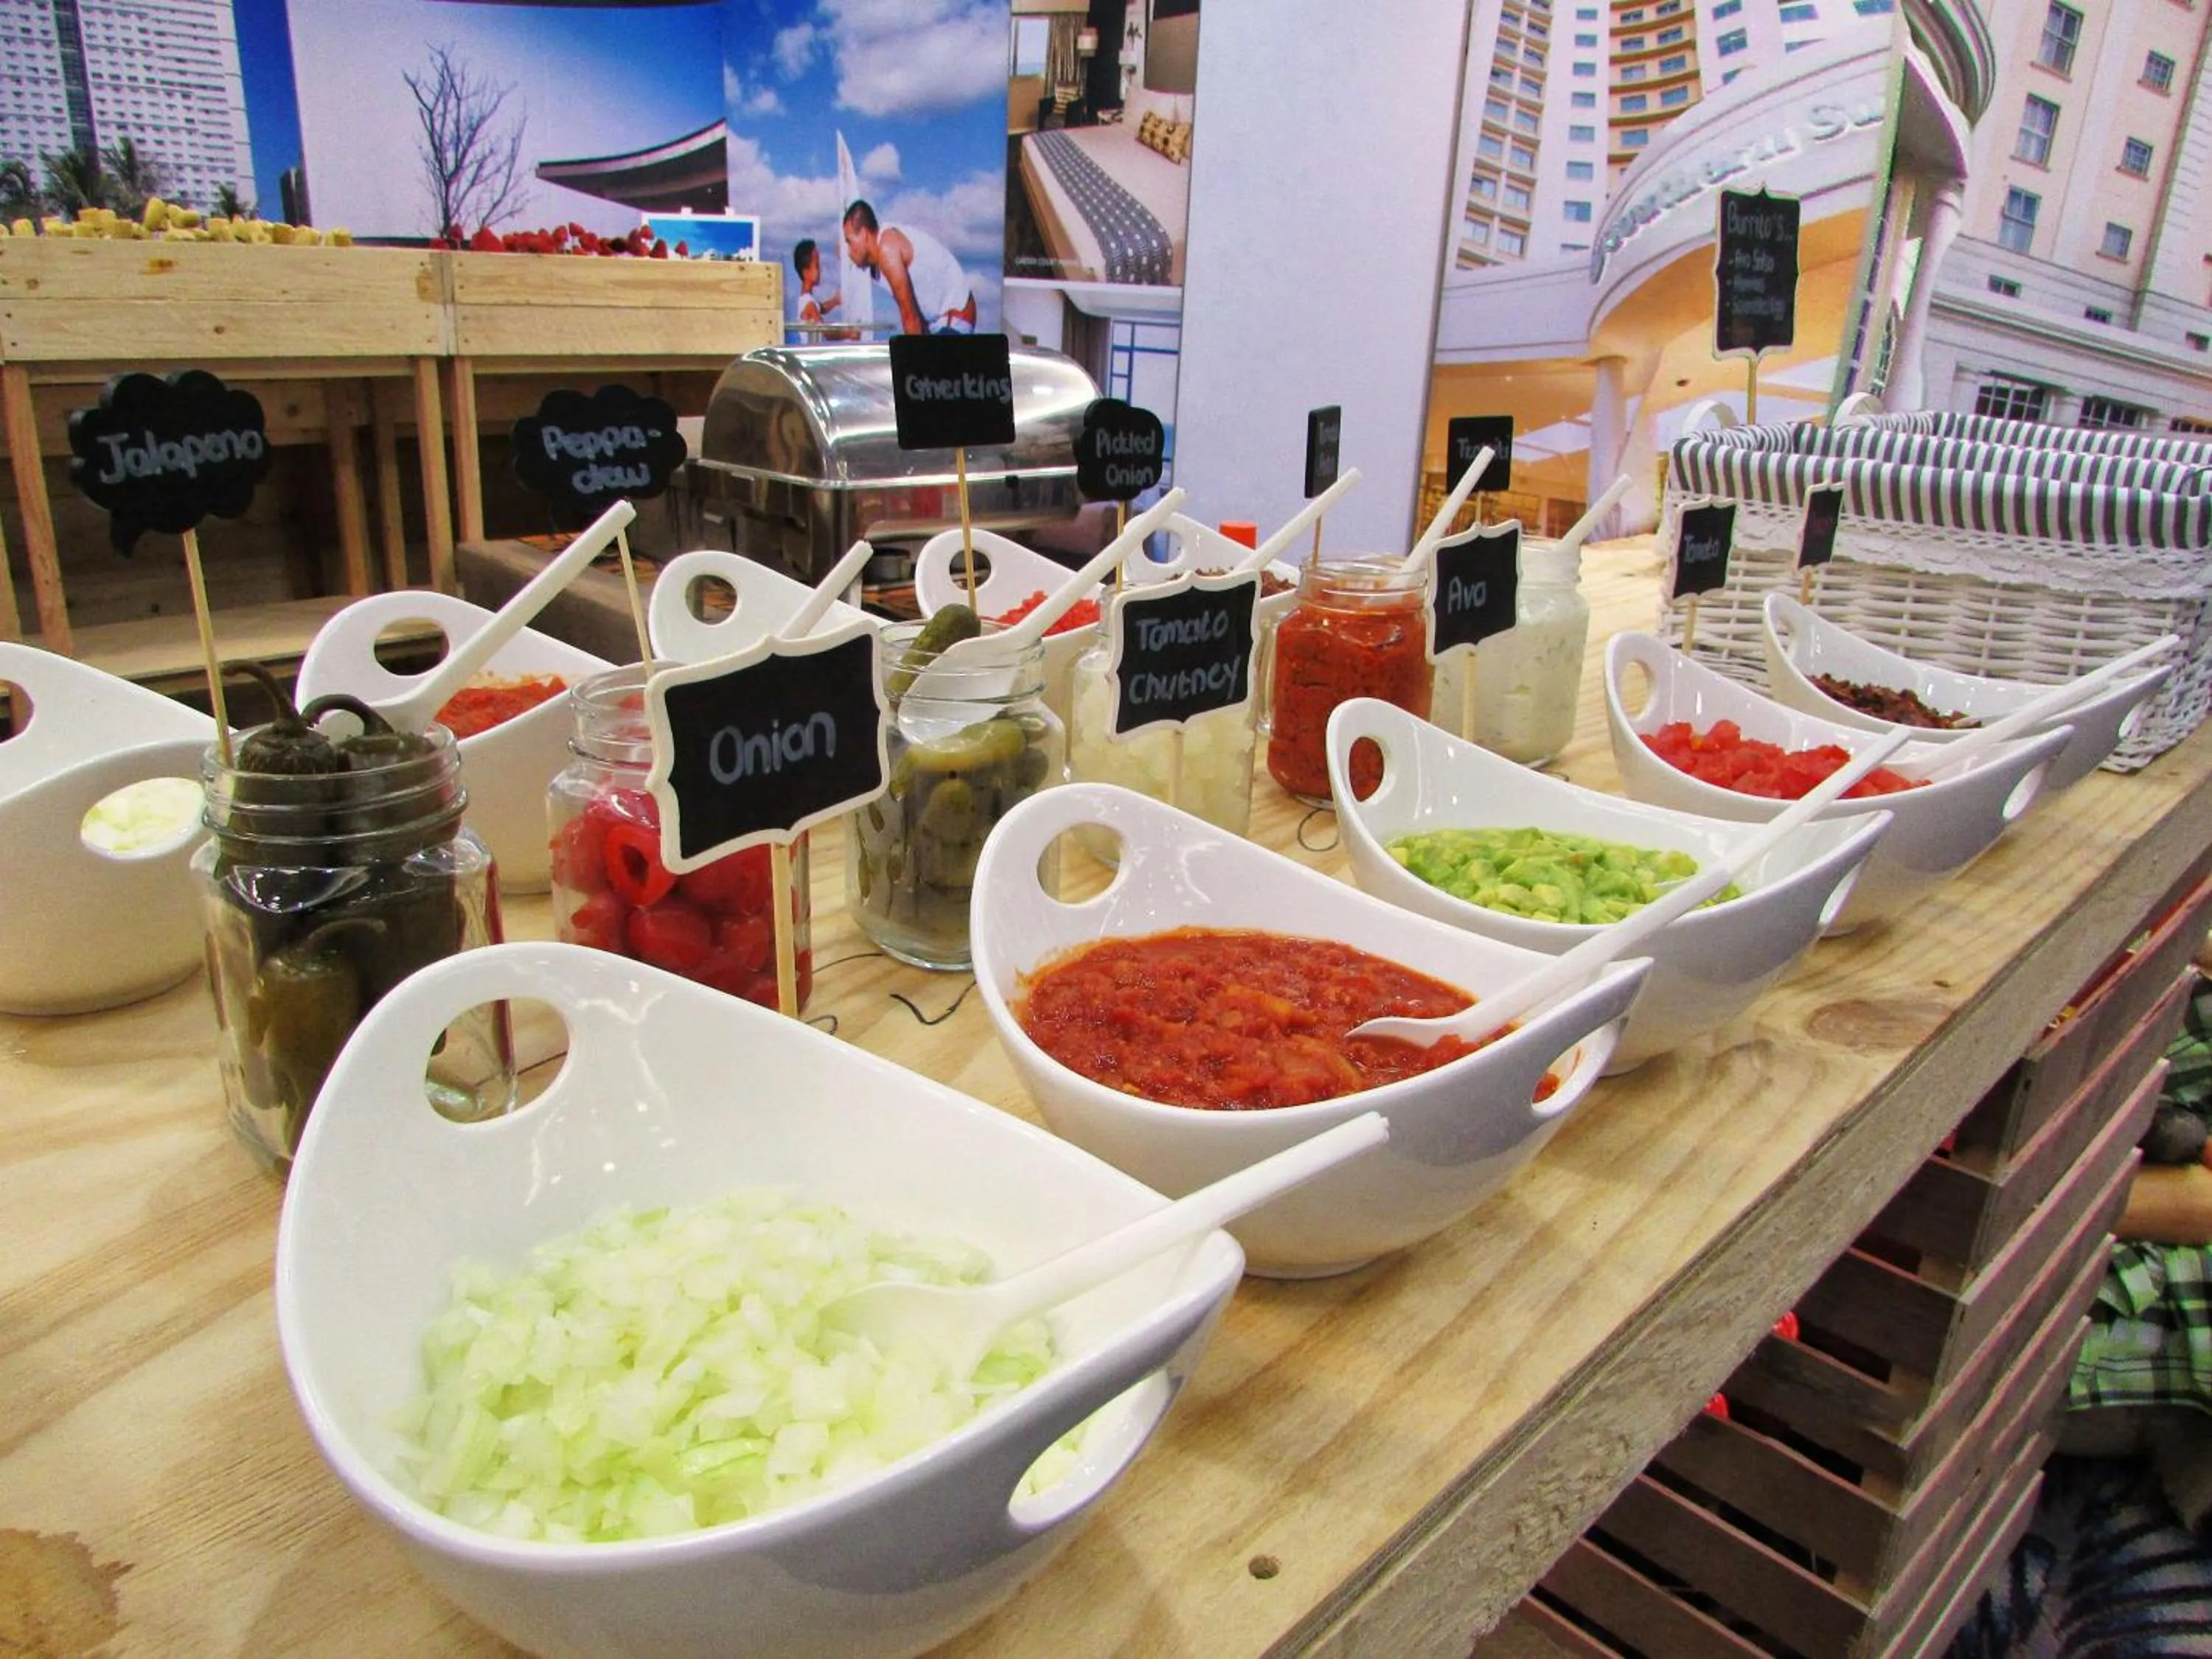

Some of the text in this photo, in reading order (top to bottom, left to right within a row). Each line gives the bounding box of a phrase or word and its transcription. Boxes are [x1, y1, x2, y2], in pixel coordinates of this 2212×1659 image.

[96, 429, 264, 484] Jalapeno
[1096, 427, 1156, 459] Pickled
[1105, 464, 1155, 487] Onion
[1447, 575, 1487, 614] Avo
[1135, 609, 1229, 652] Tomato
[709, 712, 837, 785] Onion
